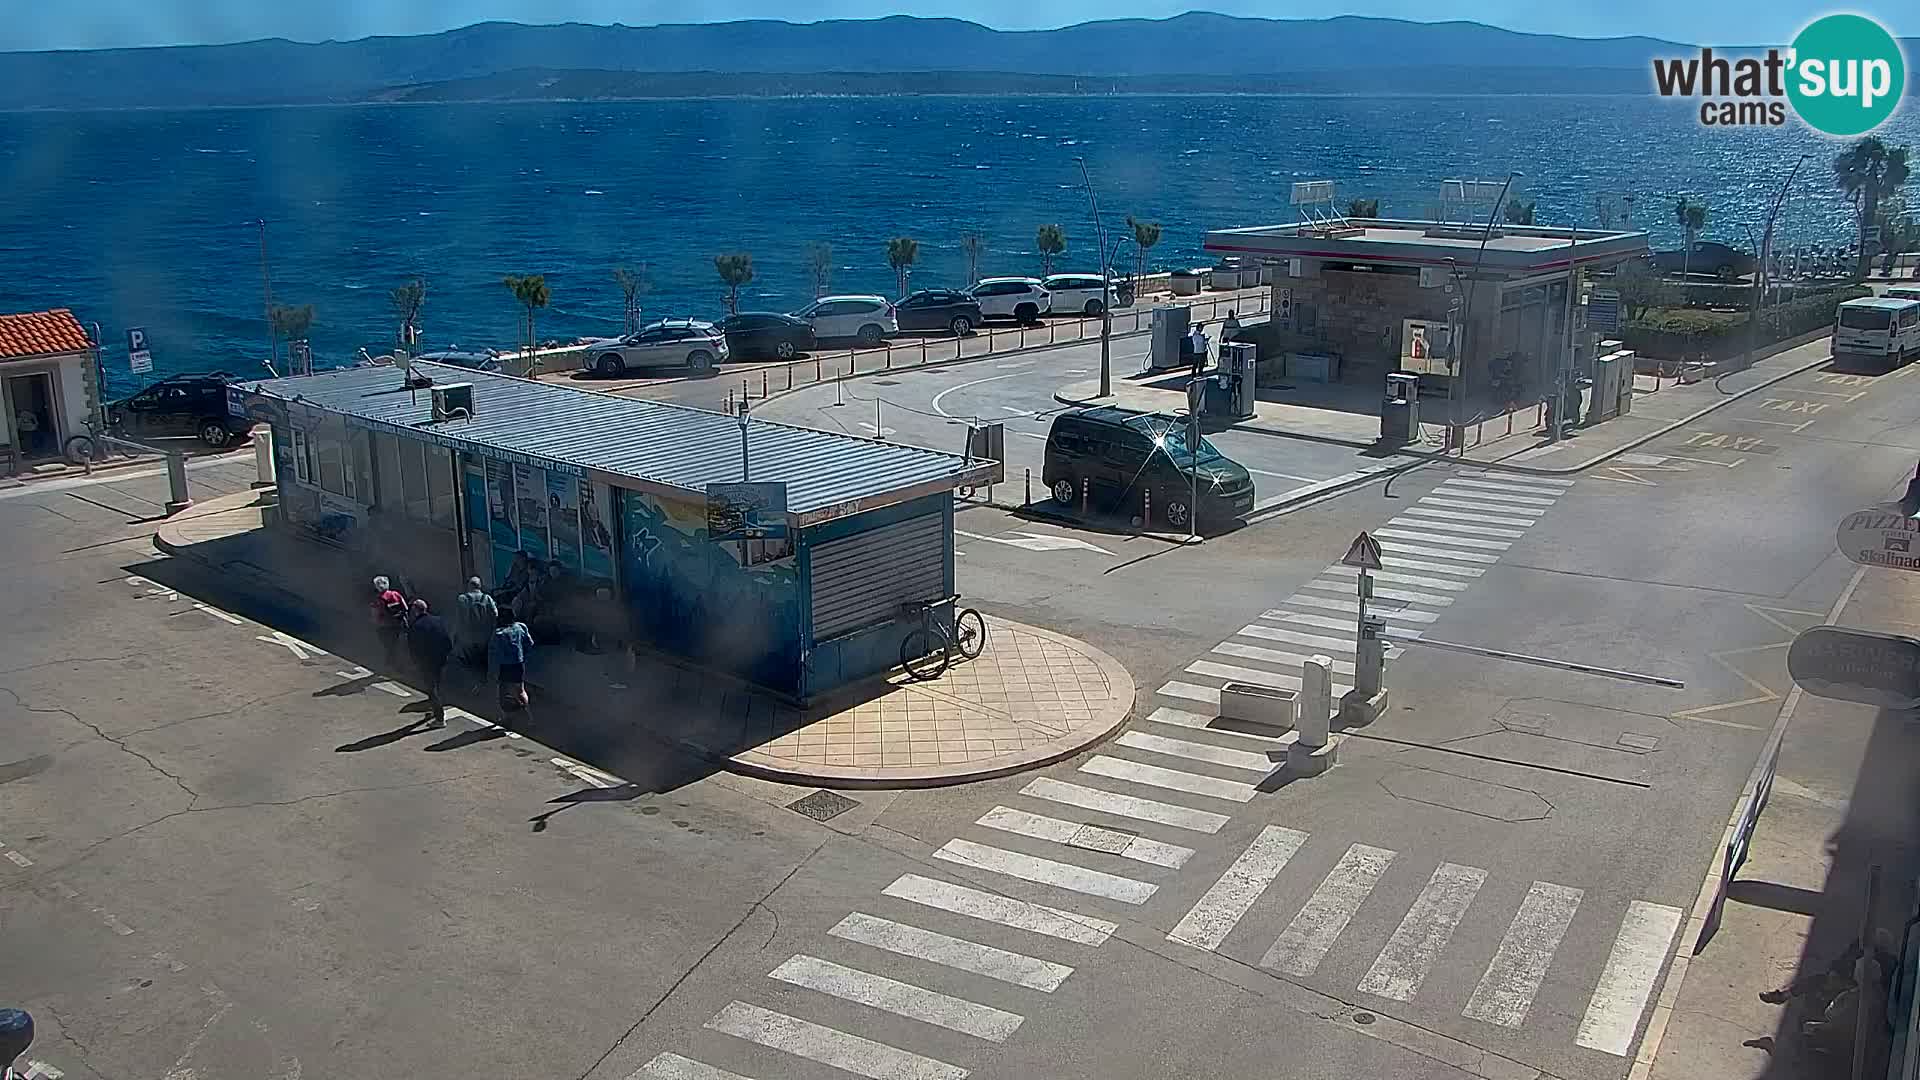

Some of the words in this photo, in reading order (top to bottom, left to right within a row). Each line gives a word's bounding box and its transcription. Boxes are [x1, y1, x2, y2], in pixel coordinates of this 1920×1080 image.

[131, 331, 144, 349] P
[1815, 374, 1878, 387] TAXI
[1759, 398, 1831, 415] TAXI
[1685, 432, 1764, 451] TAXI
[479, 447, 494, 458] BUS
[495, 449, 527, 464] STATION
[529, 457, 555, 470] TICKET
[556, 463, 583, 477] OFFICE
